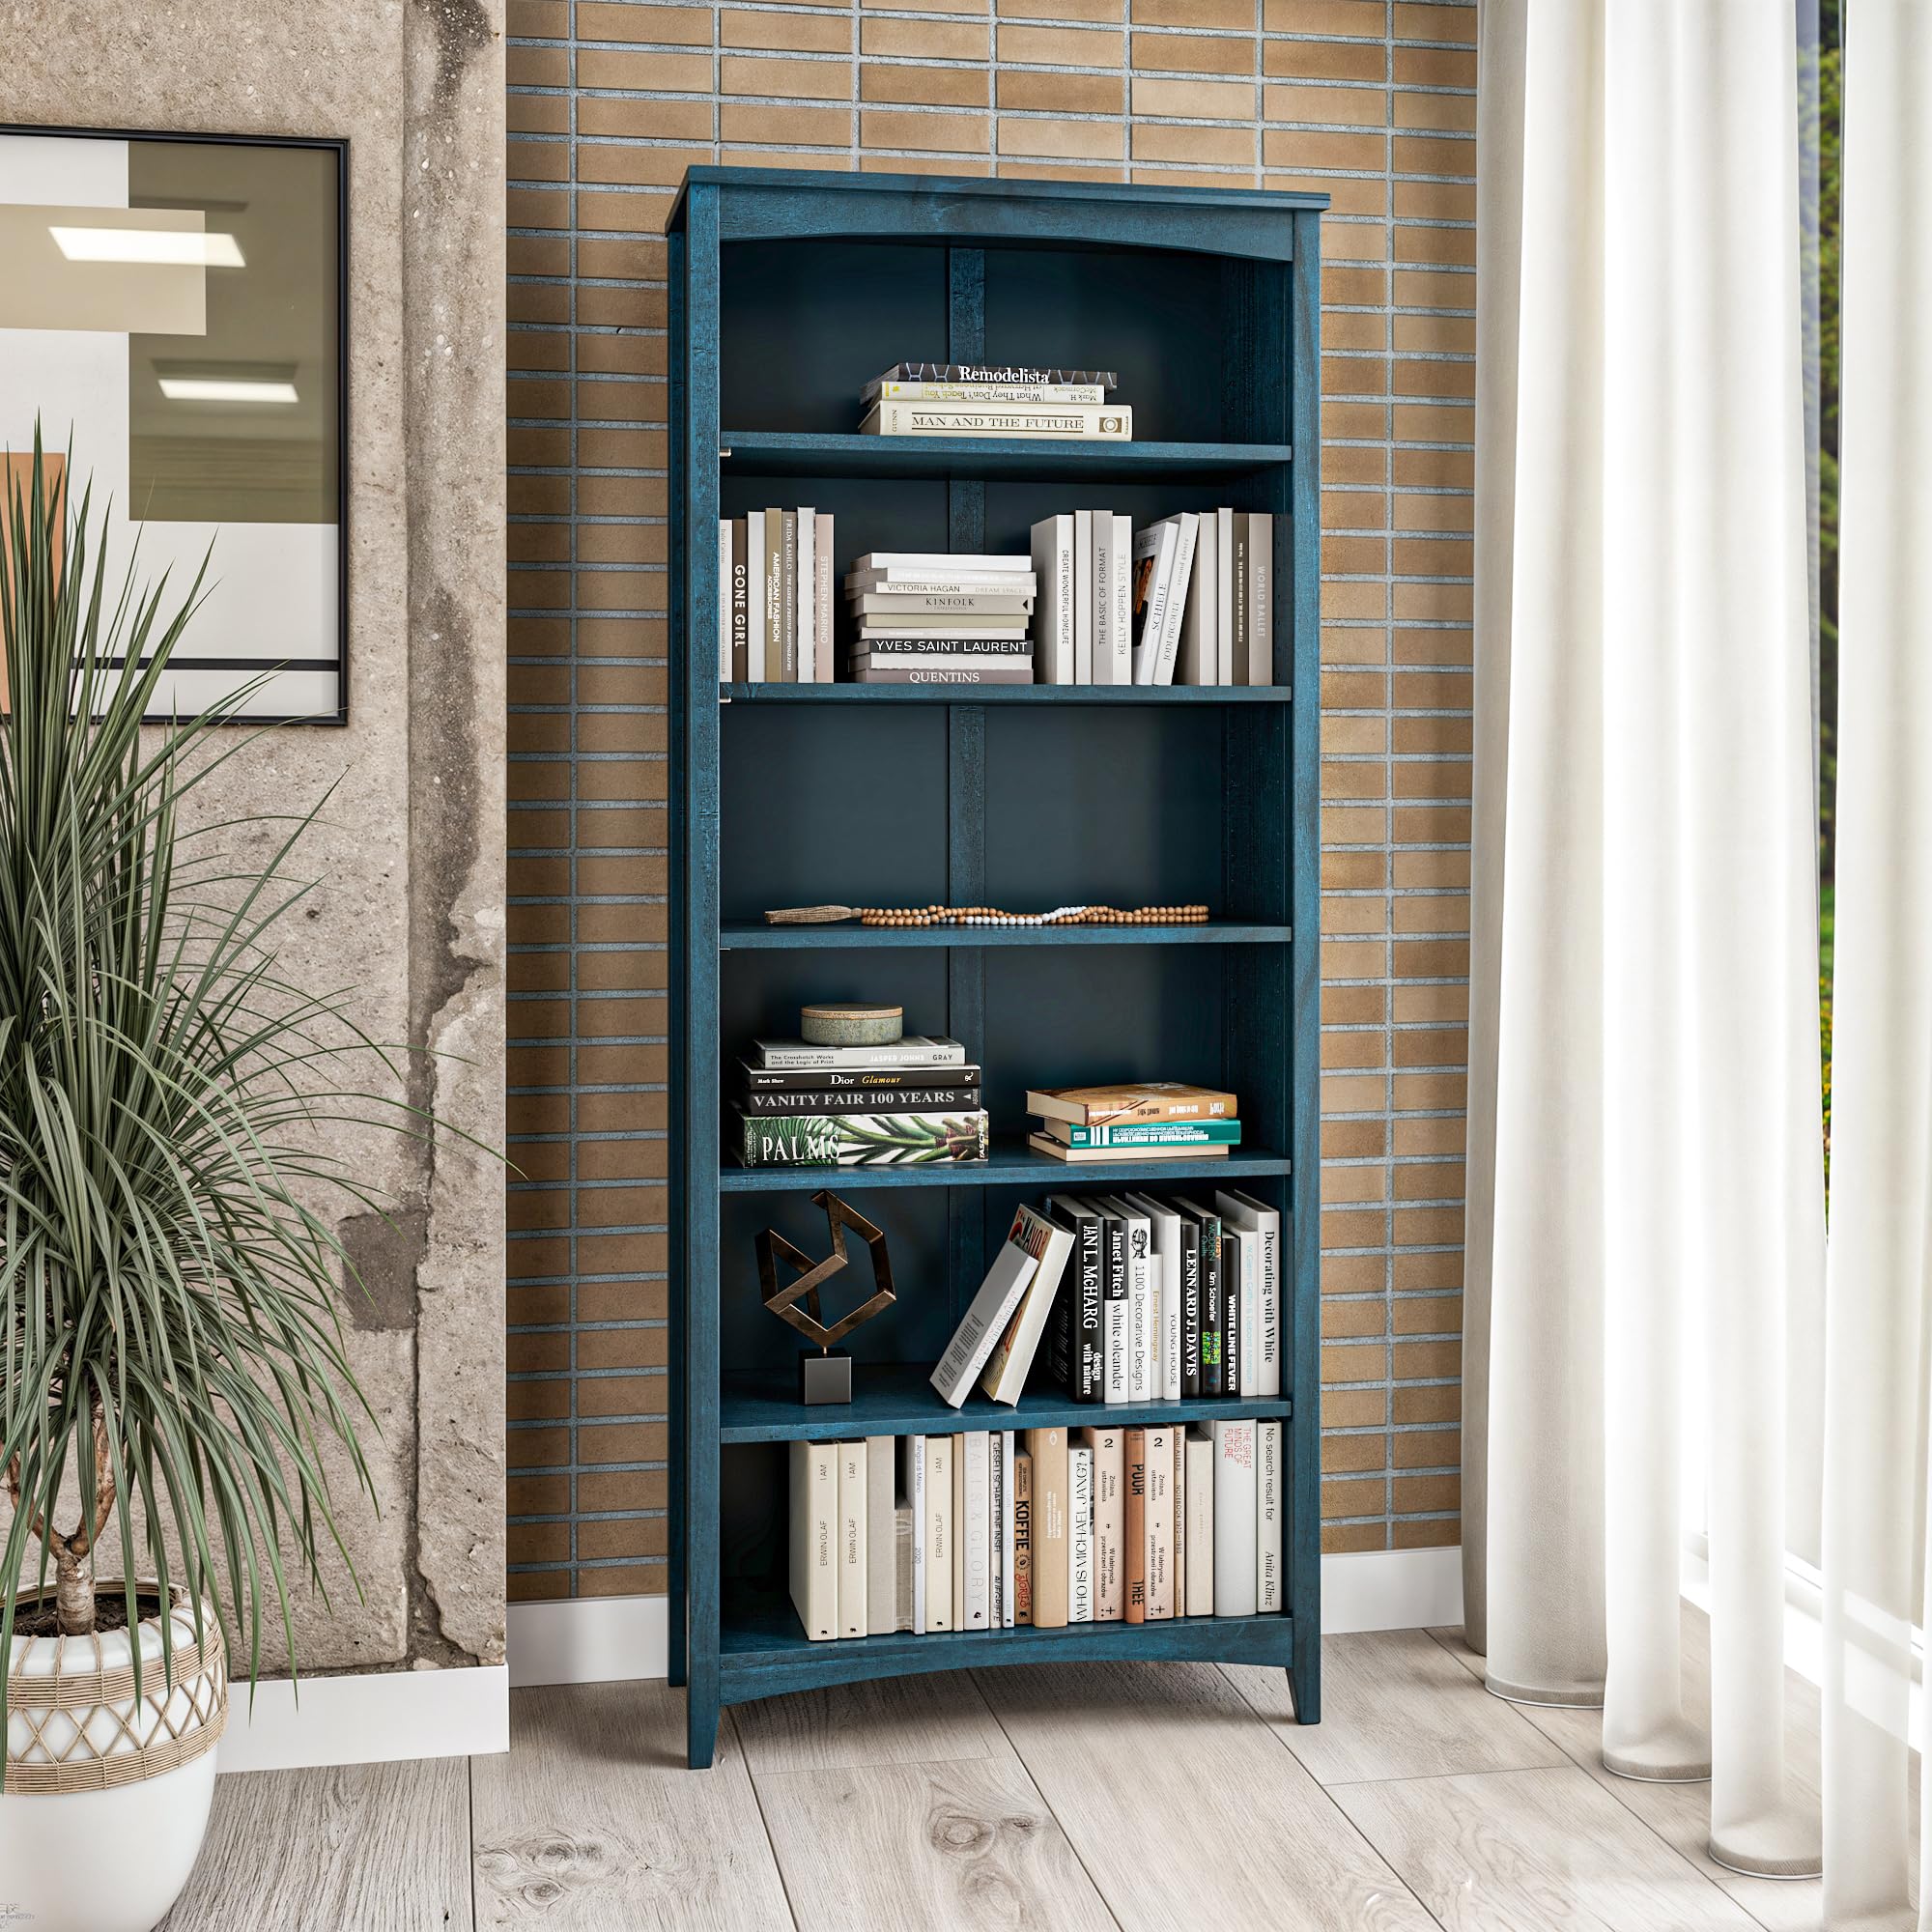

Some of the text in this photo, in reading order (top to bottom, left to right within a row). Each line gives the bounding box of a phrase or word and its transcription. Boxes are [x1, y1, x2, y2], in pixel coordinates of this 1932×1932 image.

[959, 366, 1049, 384] Remodelista
[942, 390, 965, 400] Teach
[968, 390, 990, 400] Don't
[991, 390, 1014, 401] They
[1015, 392, 1041, 402] What
[912, 415, 1084, 429] MAN AND THE FUTURE
[735, 564, 746, 647] GONE GIRL
[925, 598, 975, 607] KINFOLK
[1098, 547, 1107, 645] THE BASIC OF FORMAT
[1118, 554, 1126, 655] KELLY HOPPEN STYLE
[1151, 583, 1167, 631] SCHIELE
[1257, 566, 1265, 638] WORLD BALLET
[876, 640, 1028, 652] YVES SAINT LAURENT
[909, 672, 980, 683] QUENTINS
[831, 1074, 901, 1084] Dior Glamour
[753, 1092, 955, 1107] VANITY FAIR 100 YEARS
[761, 1134, 840, 1161] PALMS
[1083, 1249, 1098, 1262] L.
[1112, 1231, 1124, 1297] Janet Fitch
[1262, 1231, 1275, 1363] Decorating with White
[1186, 1249, 1196, 1376] LENNARD J. DAVIS
[1132, 1265, 1146, 1391] 1100 Designs
[1113, 1304, 1124, 1391] white oleander
[1227, 1294, 1236, 1391] WHITE LINE FEVER
[1083, 1343, 1094, 1395] with nature
[1092, 1352, 1103, 1381] design
[1104, 1437, 1114, 1449] 2
[1153, 1437, 1163, 1448] 2
[1243, 1428, 1252, 1469] THE GREAT
[820, 1464, 827, 1477] AM
[848, 1463, 856, 1475] AM
[935, 1457, 943, 1470] AM
[1235, 1454, 1242, 1464] OF
[1132, 1463, 1144, 1495] PUUR
[1265, 1428, 1275, 1521] No search result for
[1016, 1500, 1030, 1550] KOFFIE
[1076, 1463, 1088, 1621] WHO IS MICHAEL JANG?
[970, 1530, 983, 1602] GLORY
[1265, 1551, 1275, 1606] Anita Klinz
[1132, 1579, 1144, 1605] THEE
